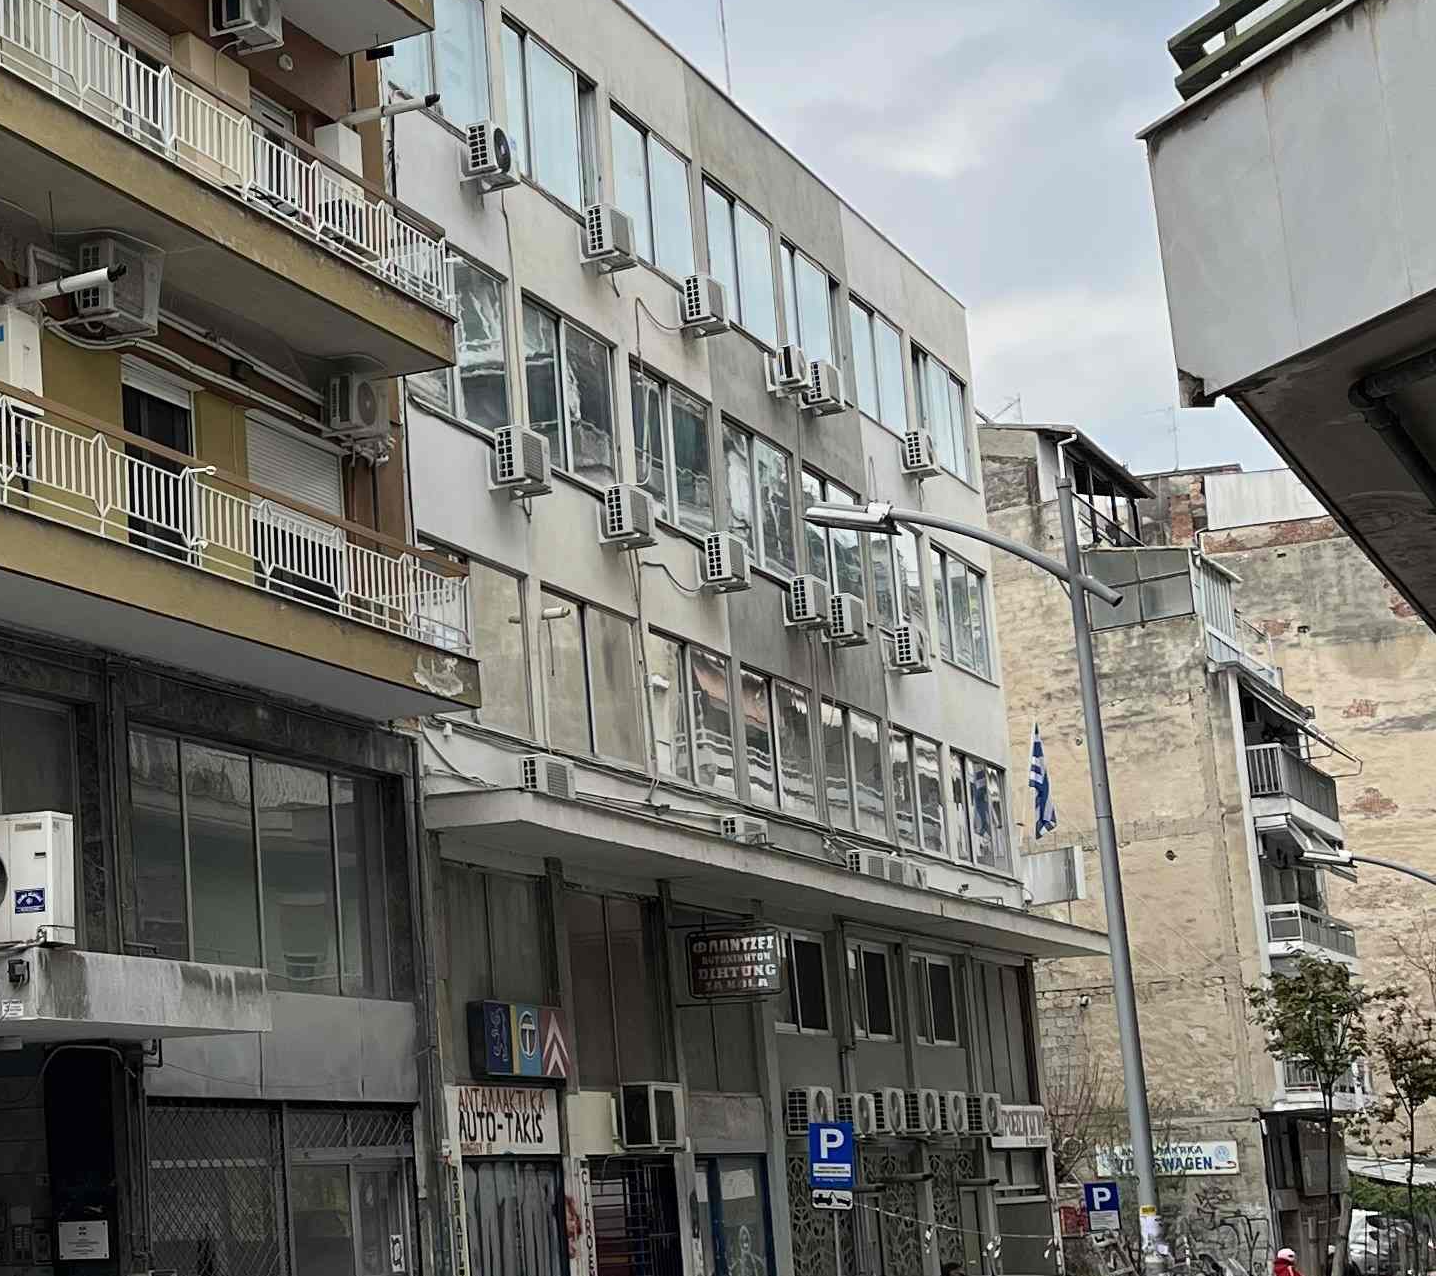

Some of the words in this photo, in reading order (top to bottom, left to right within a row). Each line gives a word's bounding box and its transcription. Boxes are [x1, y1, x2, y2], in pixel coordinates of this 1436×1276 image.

[459, 1111, 544, 1144] AUTO-TAKIS
[819, 1128, 845, 1160] P
[1091, 1187, 1112, 1211] P
